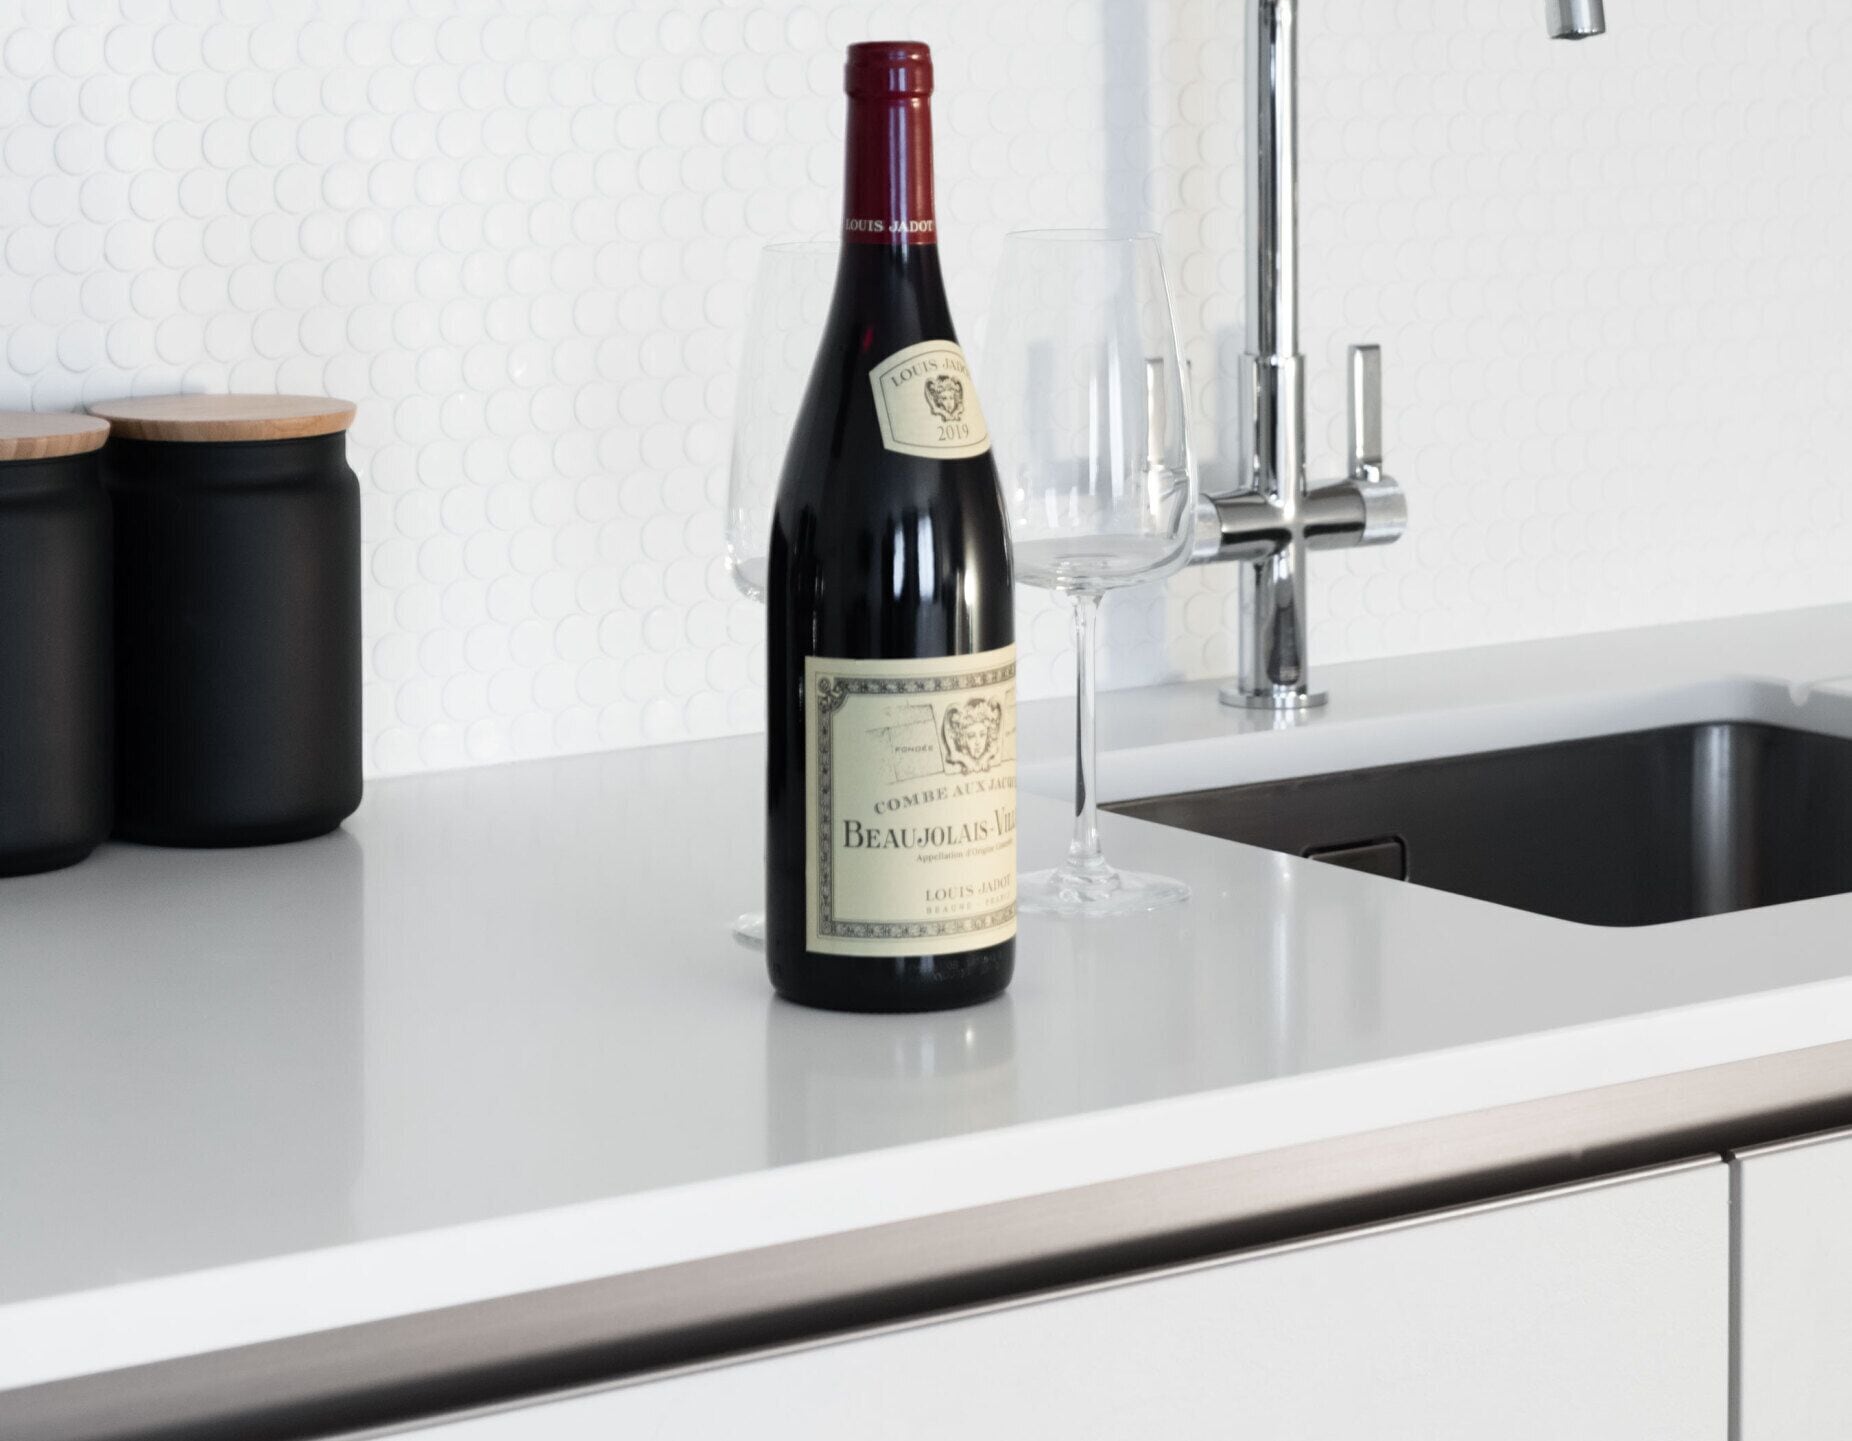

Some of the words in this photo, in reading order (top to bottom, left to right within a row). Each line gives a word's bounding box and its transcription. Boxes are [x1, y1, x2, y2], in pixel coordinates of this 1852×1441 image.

[845, 219, 884, 233] LOUIS
[888, 220, 933, 233] JADOT
[891, 359, 938, 388] LOUIS
[937, 423, 969, 441] 2019
[873, 786, 948, 815] COMBE
[952, 783, 985, 798] AUX
[917, 851, 964, 864] Appellation
[925, 883, 975, 902] LOUIS
[978, 872, 1011, 894] JADOT
